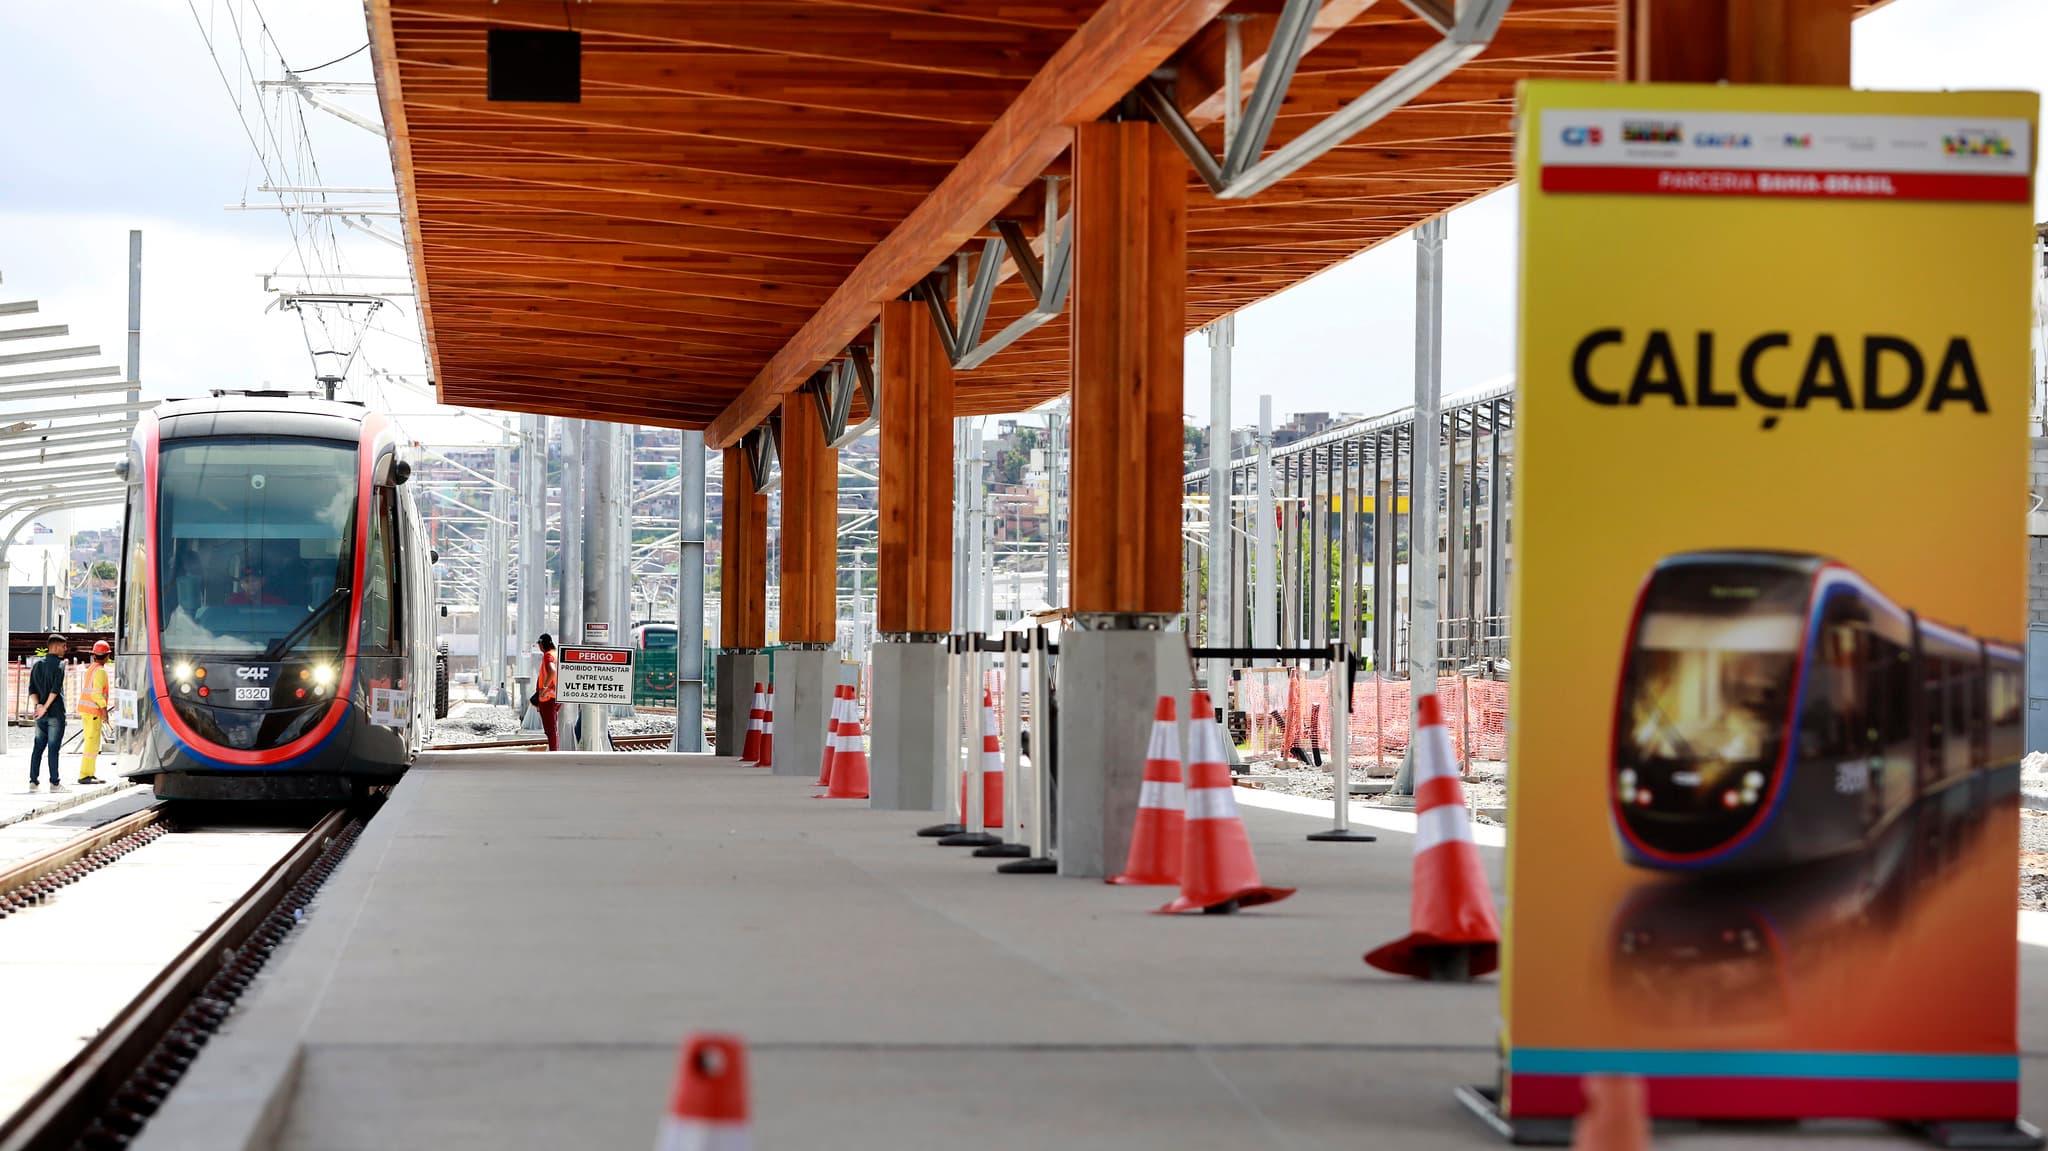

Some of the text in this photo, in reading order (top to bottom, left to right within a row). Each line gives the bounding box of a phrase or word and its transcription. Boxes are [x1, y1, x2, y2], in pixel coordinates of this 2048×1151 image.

[1658, 171, 1896, 195] PARCERIA BAHIA-BRASIL
[1570, 327, 1990, 430] CALÇADA
[579, 652, 614, 661] PERIGO
[236, 666, 270, 680] CAF
[561, 664, 593, 672] PROIBIDO
[565, 682, 624, 692] VLT EM TESTE
[238, 688, 268, 699] 3320
